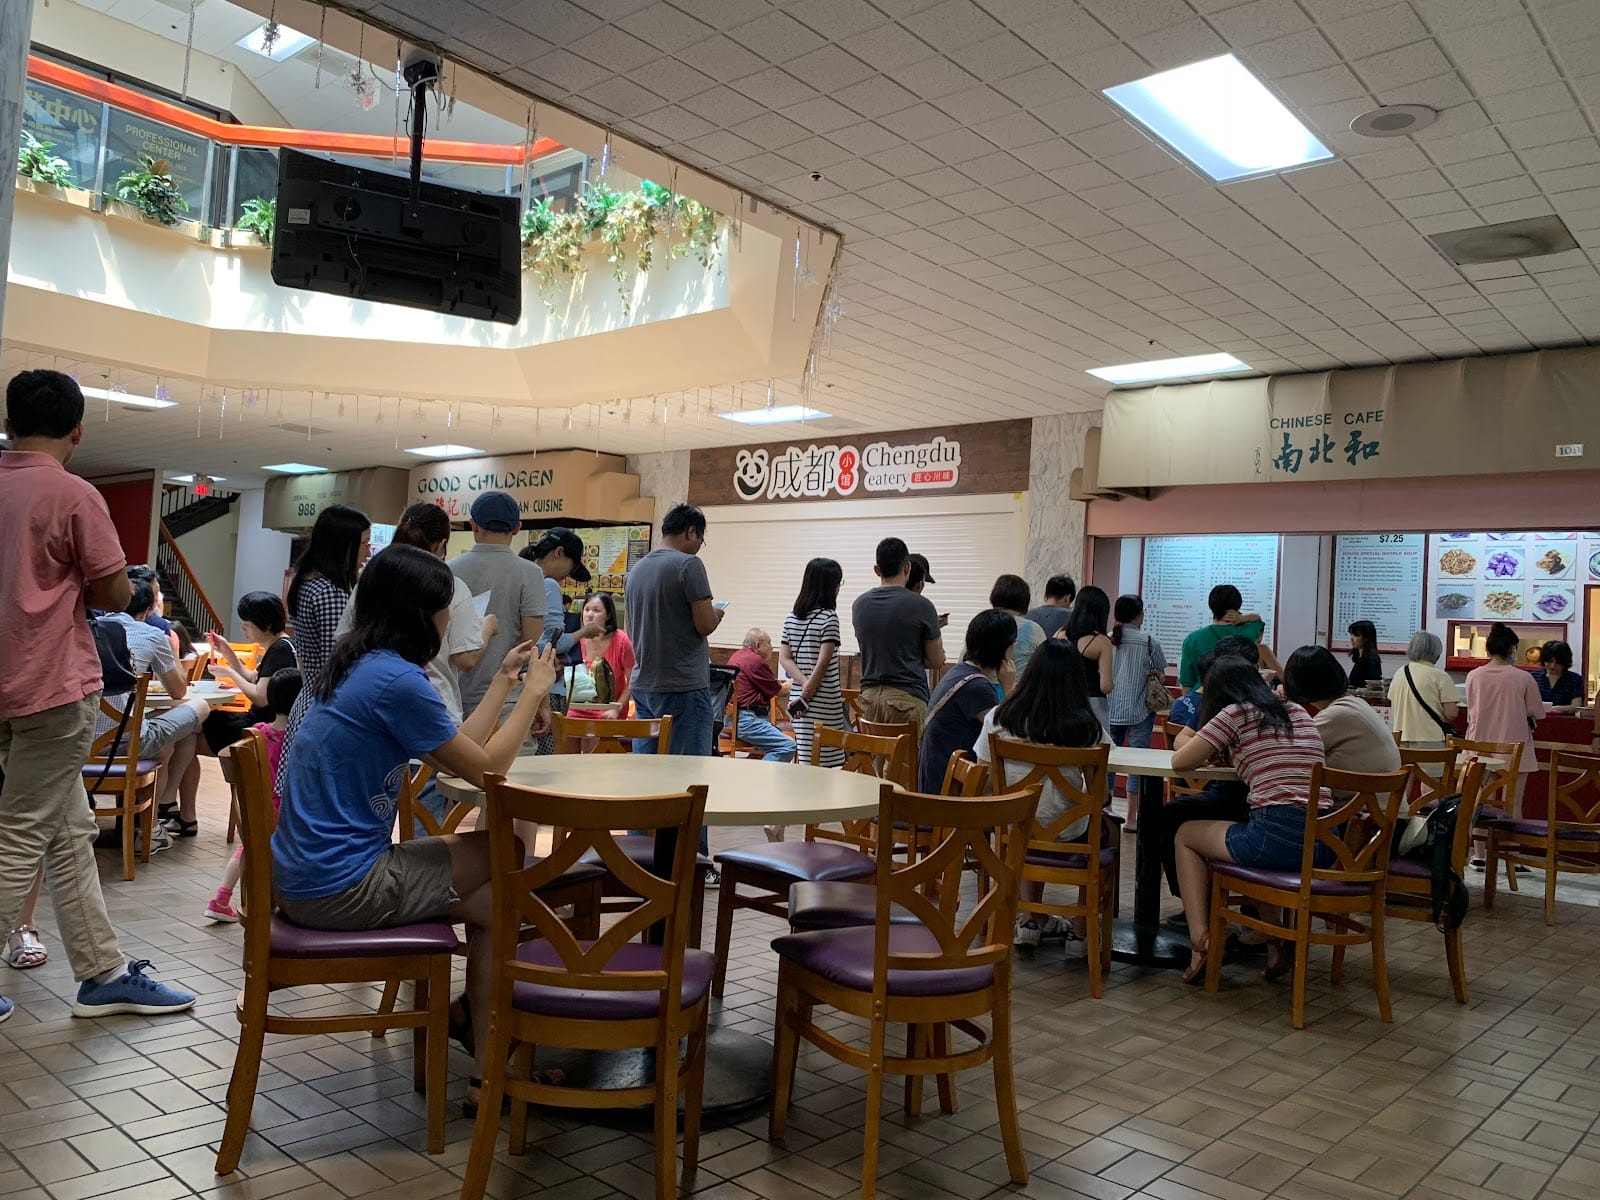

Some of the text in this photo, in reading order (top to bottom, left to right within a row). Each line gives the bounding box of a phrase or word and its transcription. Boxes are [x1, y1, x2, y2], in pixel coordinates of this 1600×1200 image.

[125, 124, 198, 157] PROFESSIONAL
[142, 141, 181, 161] CENTER
[1270, 410, 1384, 429] CHINESE CAFE
[866, 442, 955, 468] Chengdu
[1272, 430, 1380, 474] 南北和
[417, 469, 553, 494] GOOD CHILDREN
[772, 450, 835, 493] 成都
[868, 472, 909, 488] eatery
[297, 503, 316, 517] 988
[533, 499, 563, 513] CUISINE
[1379, 534, 1404, 543] $7.25
